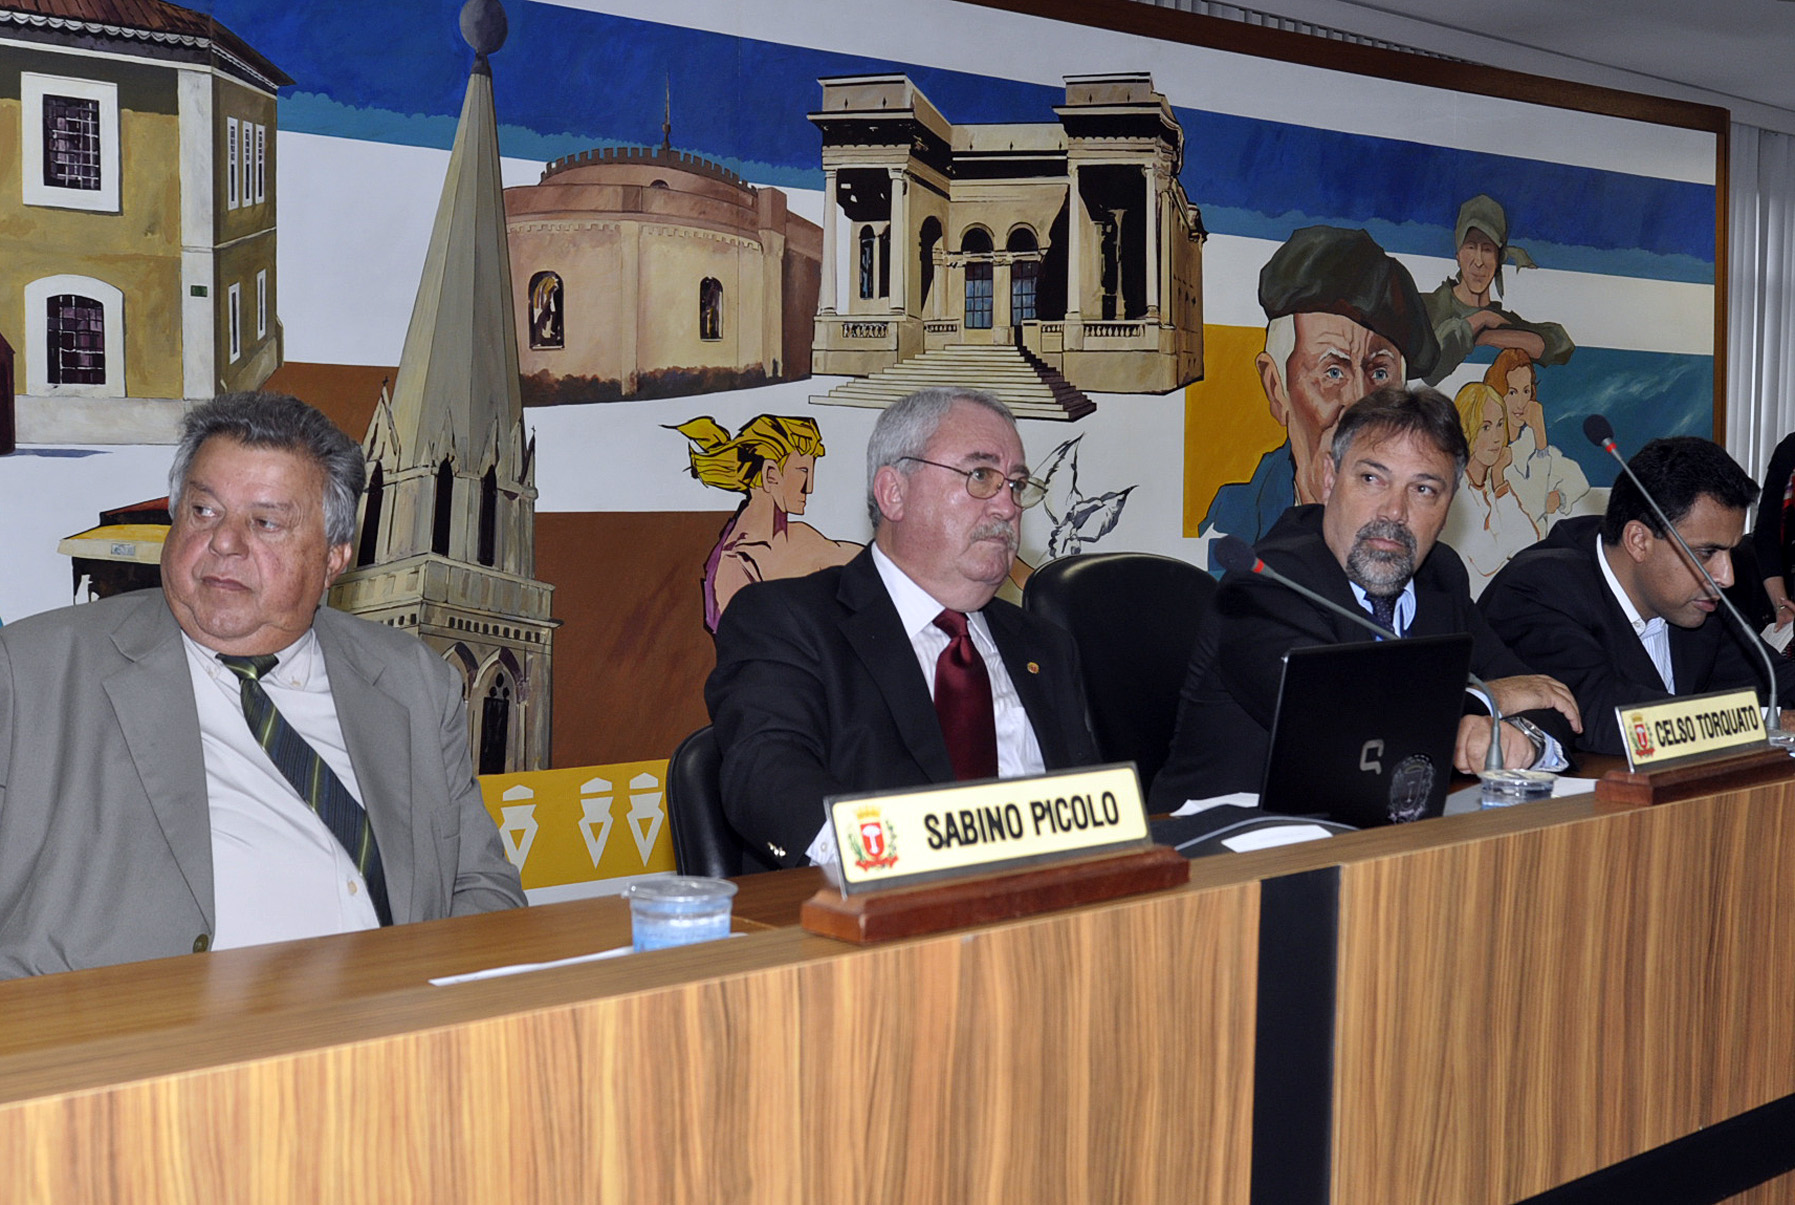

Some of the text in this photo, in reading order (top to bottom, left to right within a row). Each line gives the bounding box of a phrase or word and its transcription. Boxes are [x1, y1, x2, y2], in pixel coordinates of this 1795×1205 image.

[1655, 705, 1758, 747] CELSO TORQUATO
[924, 791, 1119, 850] SABINO PICOLO
